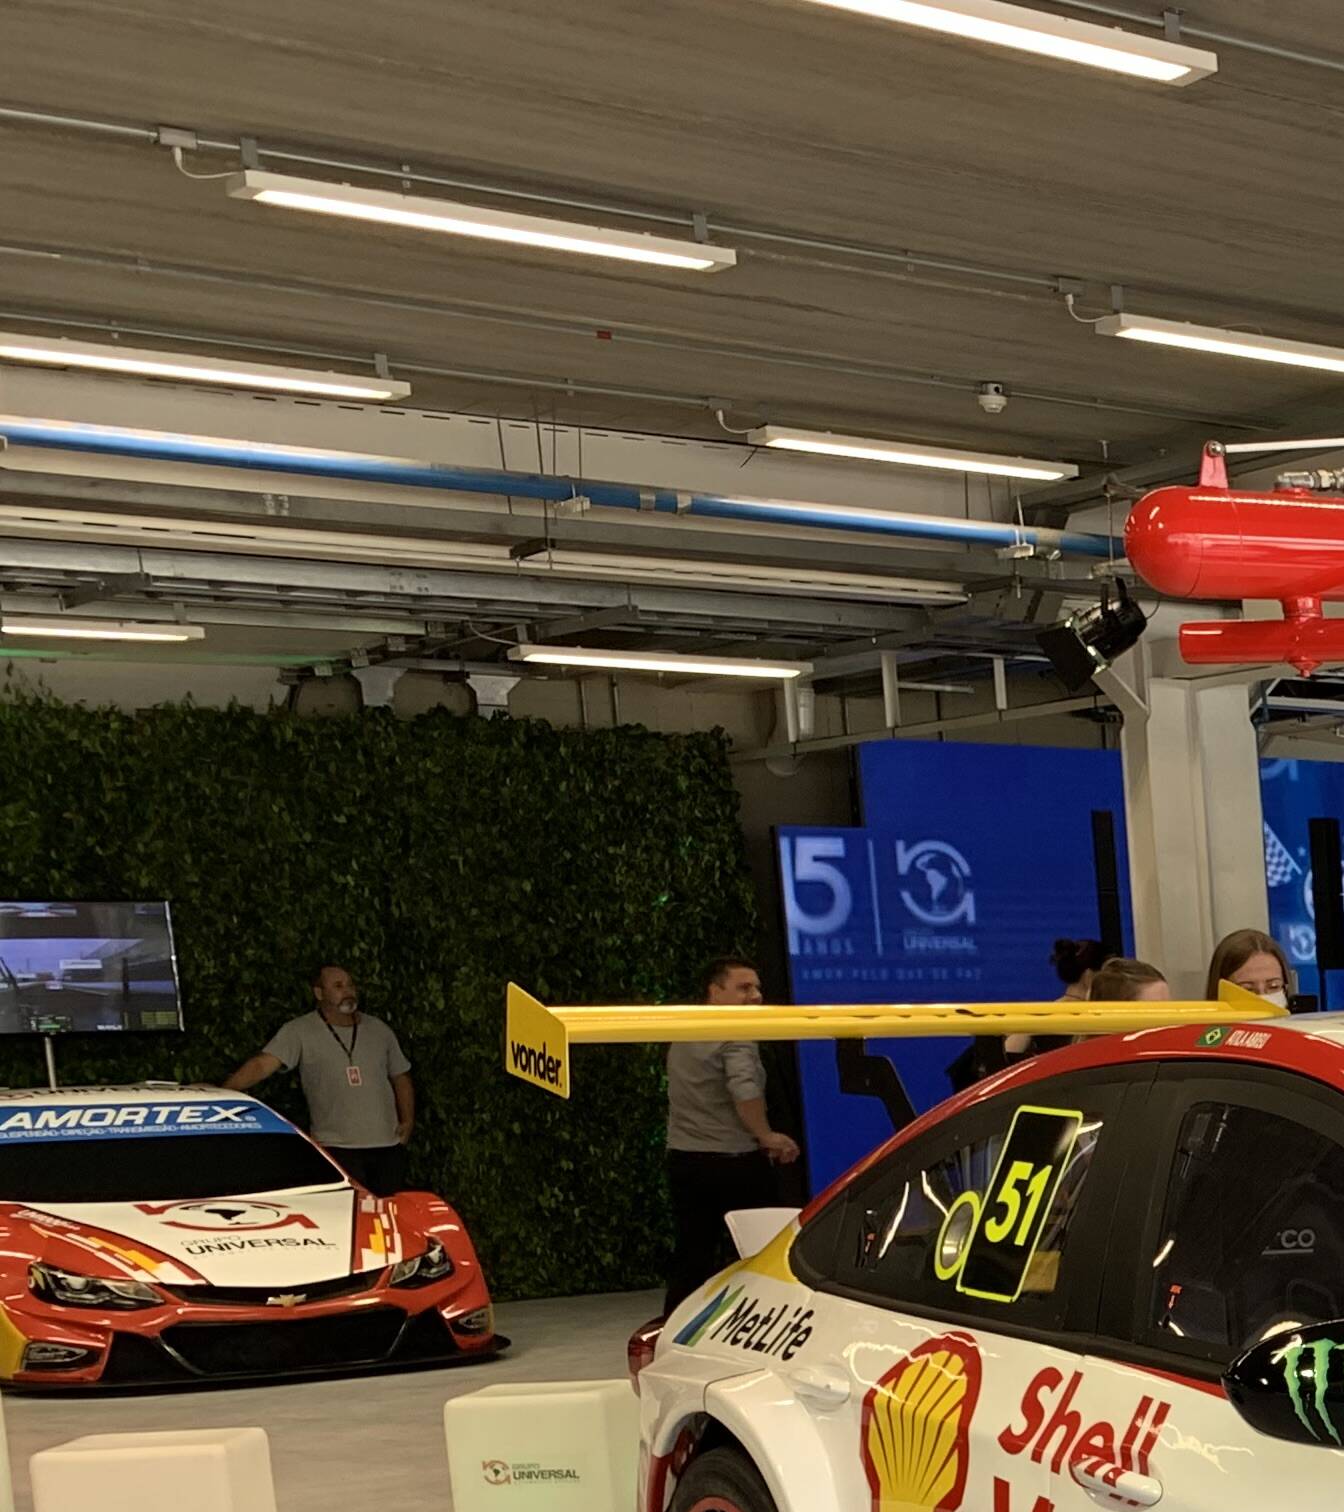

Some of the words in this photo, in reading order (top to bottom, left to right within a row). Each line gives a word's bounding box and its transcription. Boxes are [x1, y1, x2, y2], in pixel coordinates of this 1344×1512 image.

[510, 1040, 562, 1087] vonder
[0, 1106, 251, 1131] AMORTEX
[983, 1161, 1052, 1247] 51
[185, 1238, 337, 1256] UNIVERSAL
[712, 1288, 814, 1361] MetLife
[998, 1366, 1171, 1505] Shell
[512, 1469, 580, 1480] UNIVERSAL
